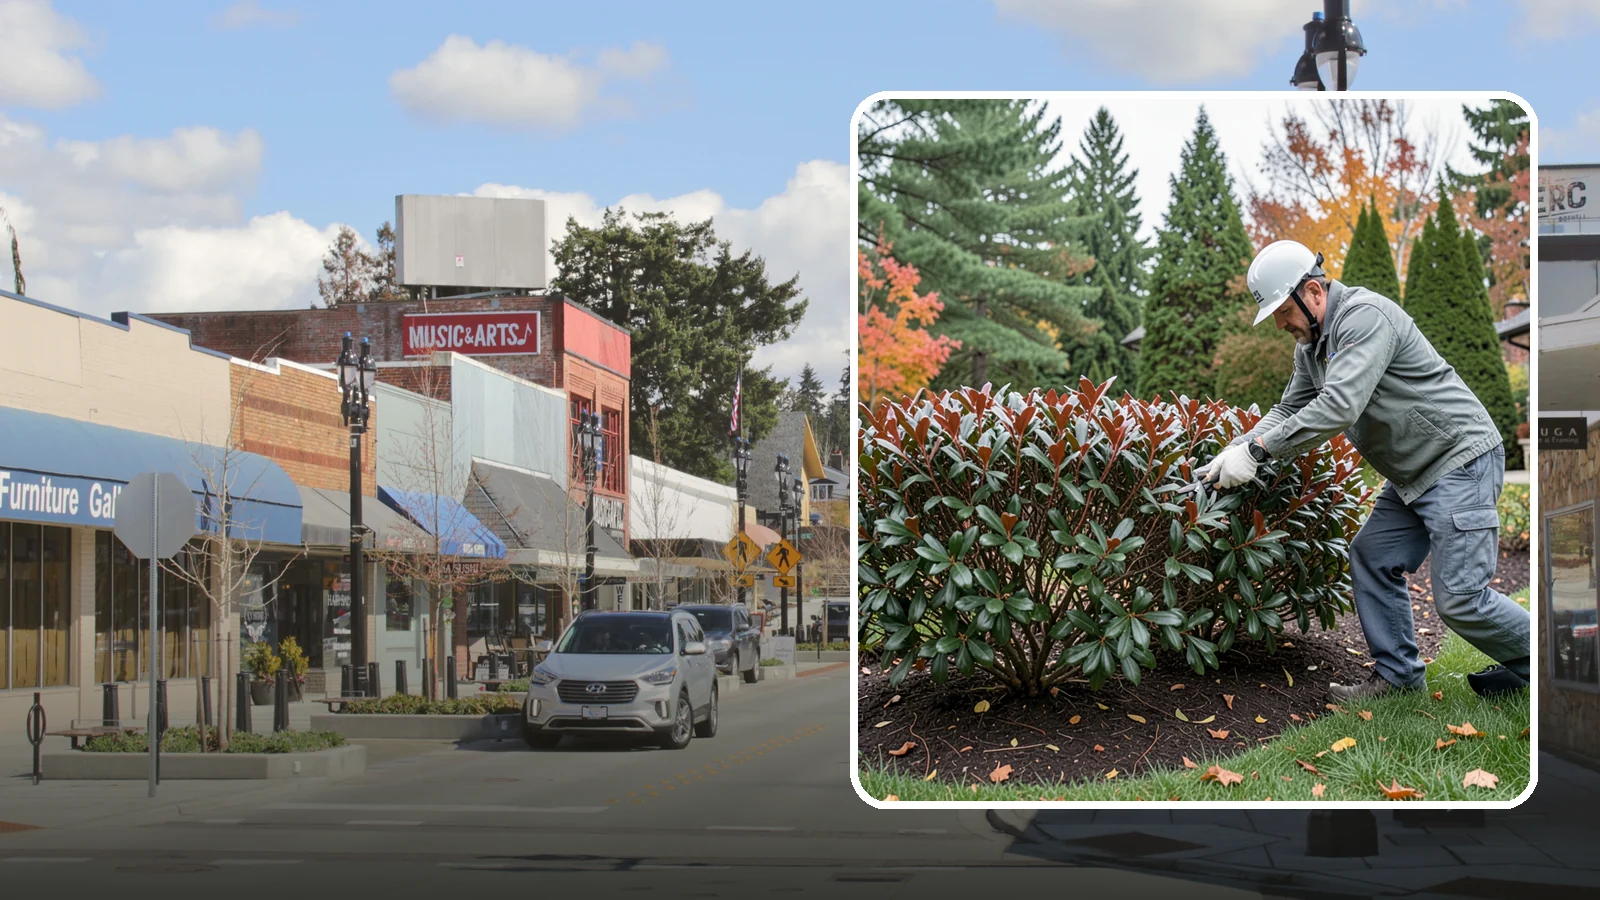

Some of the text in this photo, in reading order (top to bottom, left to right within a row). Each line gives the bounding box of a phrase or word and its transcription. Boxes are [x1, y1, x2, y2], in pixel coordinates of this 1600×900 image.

[409, 322, 519, 349] MUSIC&ARTS
[0, 471, 121, 519] Furniture Gal
[453, 563, 479, 574] SUSHI
